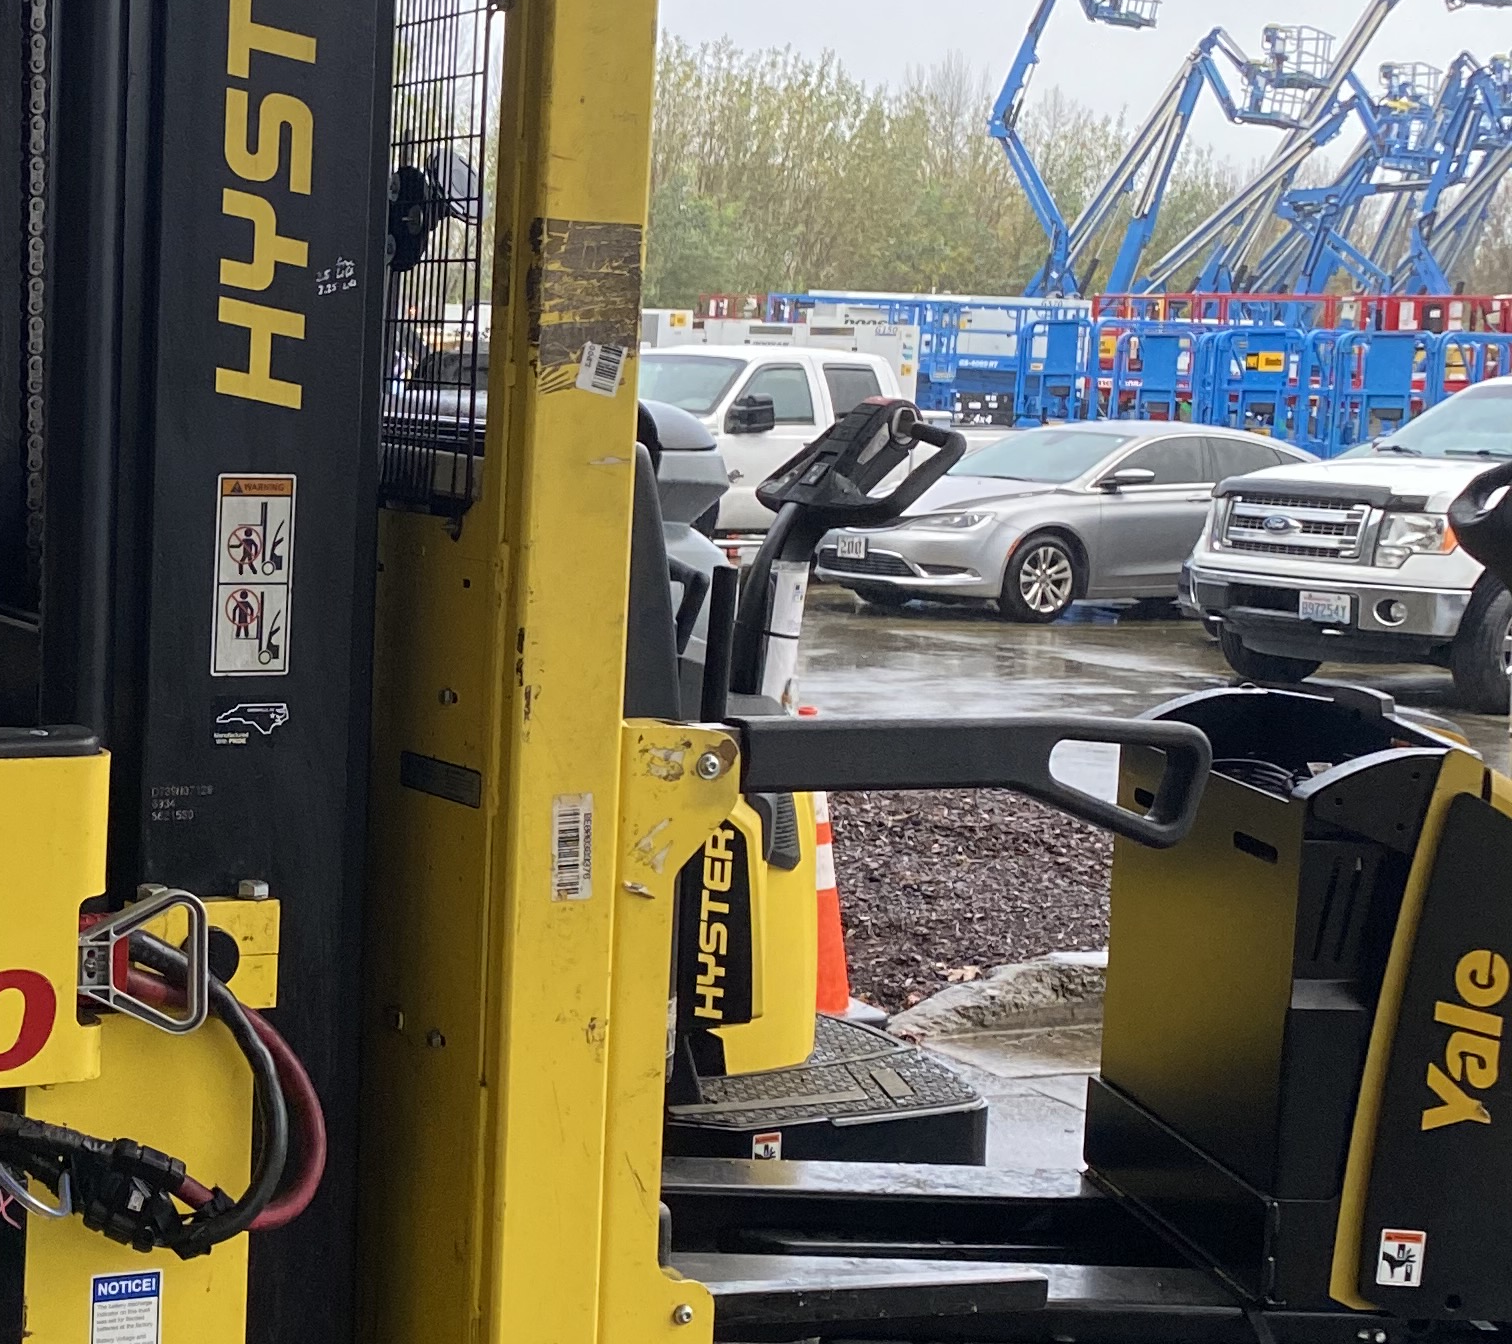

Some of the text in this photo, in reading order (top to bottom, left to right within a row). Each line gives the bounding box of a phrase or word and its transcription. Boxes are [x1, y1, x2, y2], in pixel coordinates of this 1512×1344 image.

[244, 482, 285, 493] WARNING
[694, 826, 736, 1020] HYSTER
[1421, 949, 1510, 1131] Yale
